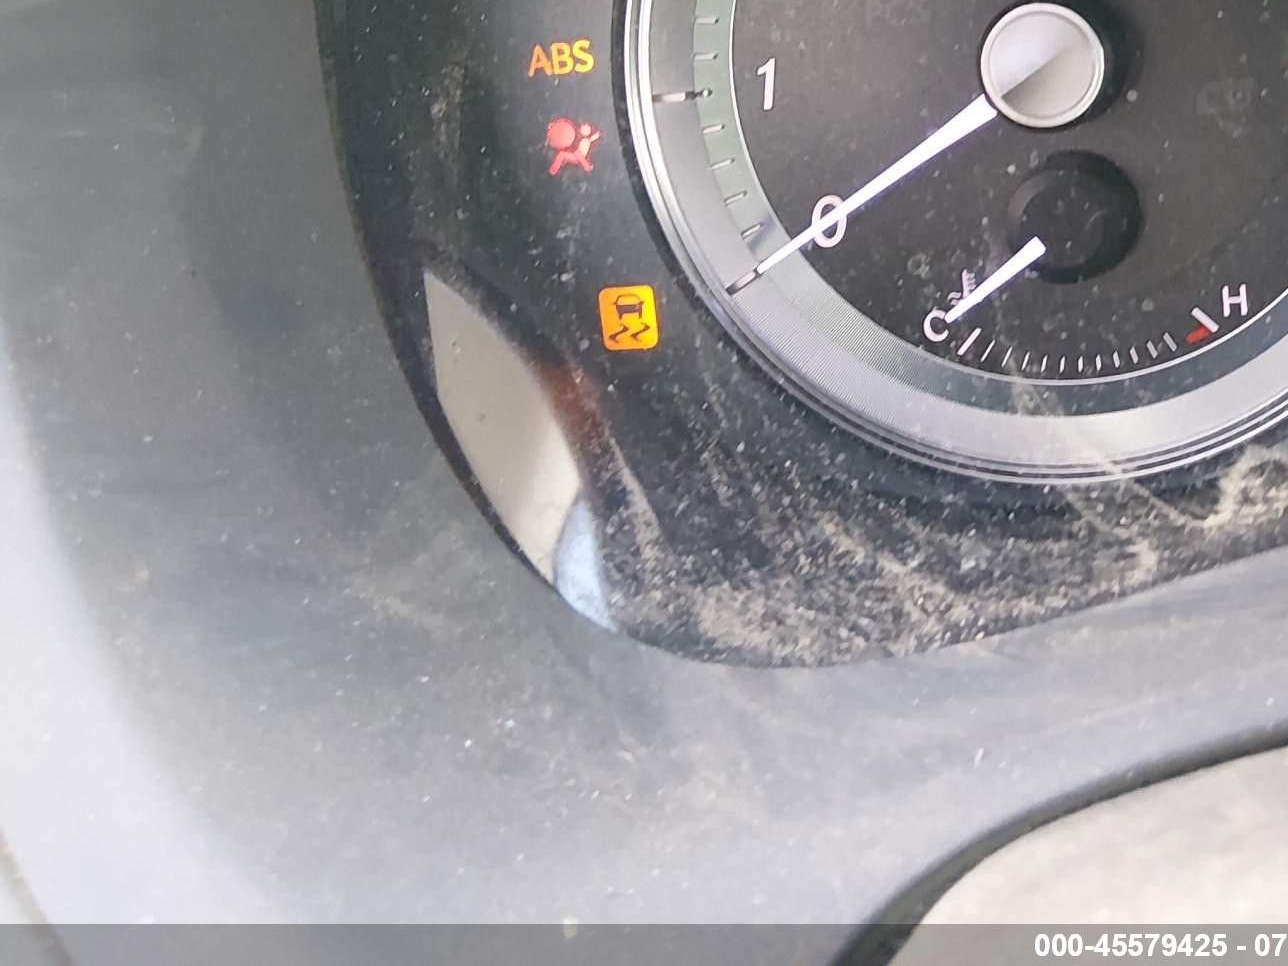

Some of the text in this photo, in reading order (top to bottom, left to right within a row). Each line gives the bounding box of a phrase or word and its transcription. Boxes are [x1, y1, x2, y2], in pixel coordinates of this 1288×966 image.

[527, 39, 595, 77] ABS
[755, 57, 777, 110] 1
[811, 194, 848, 248] 0
[1222, 285, 1249, 315] H
[922, 313, 952, 343] C
